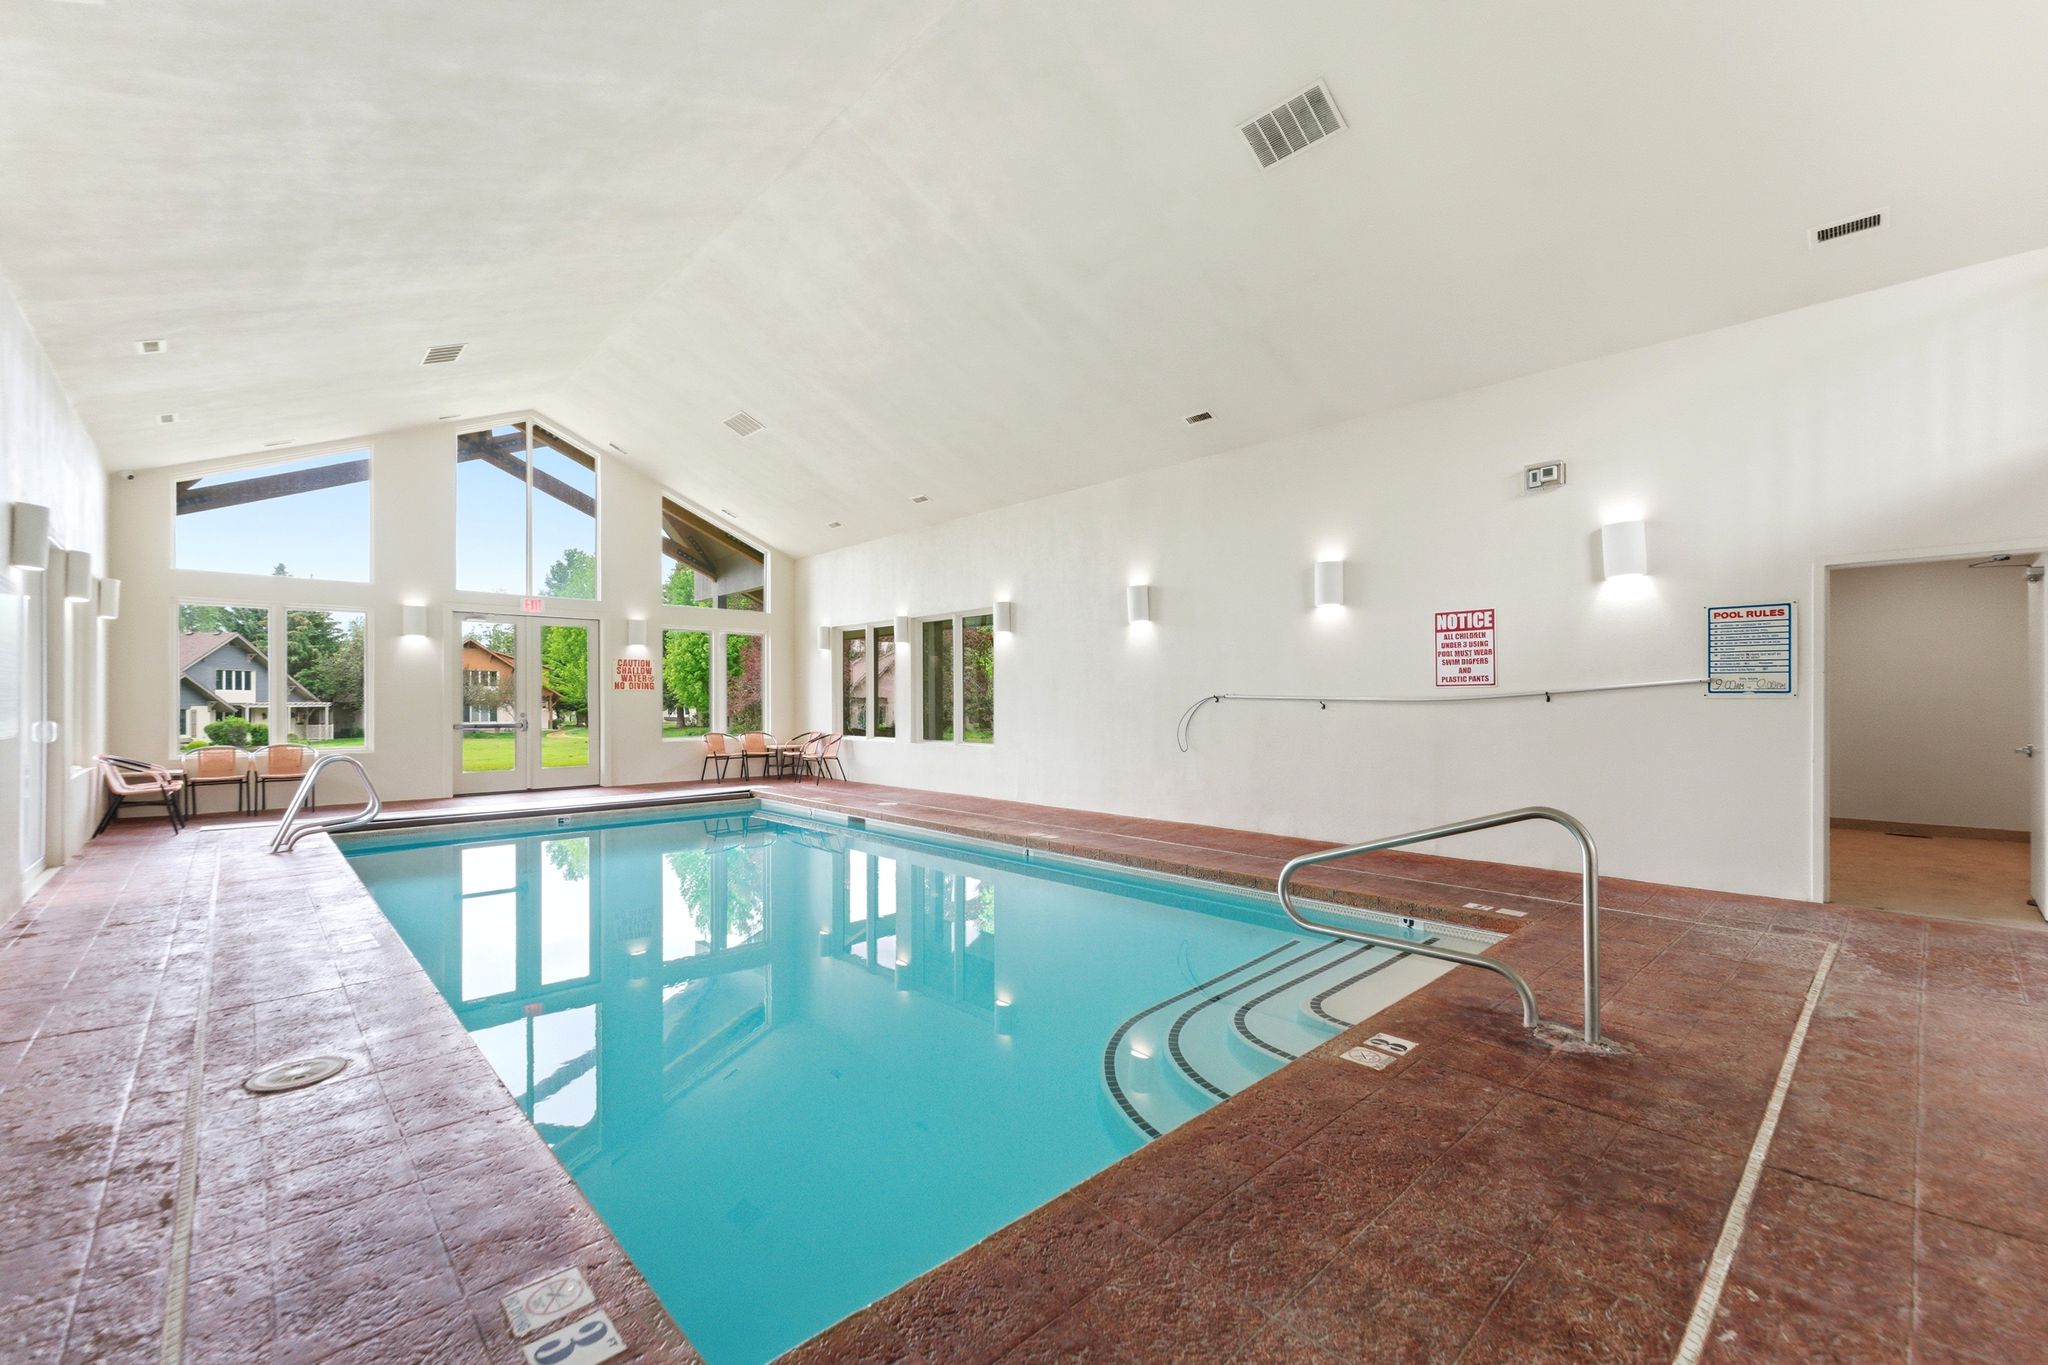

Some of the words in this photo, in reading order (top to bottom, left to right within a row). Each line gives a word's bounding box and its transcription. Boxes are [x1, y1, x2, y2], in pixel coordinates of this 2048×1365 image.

[1714, 611, 1744, 619] POOL
[1746, 608, 1785, 618] RULES
[1437, 611, 1492, 630] NOTICE
[1455, 632, 1486, 640] CHILDREN
[1455, 649, 1472, 657] MUST
[617, 659, 651, 667] CAUTION
[616, 667, 652, 675] SHALLOW
[614, 682, 625, 690] NO
[629, 682, 655, 690] DIVING
[534, 1320, 608, 1365] 3
